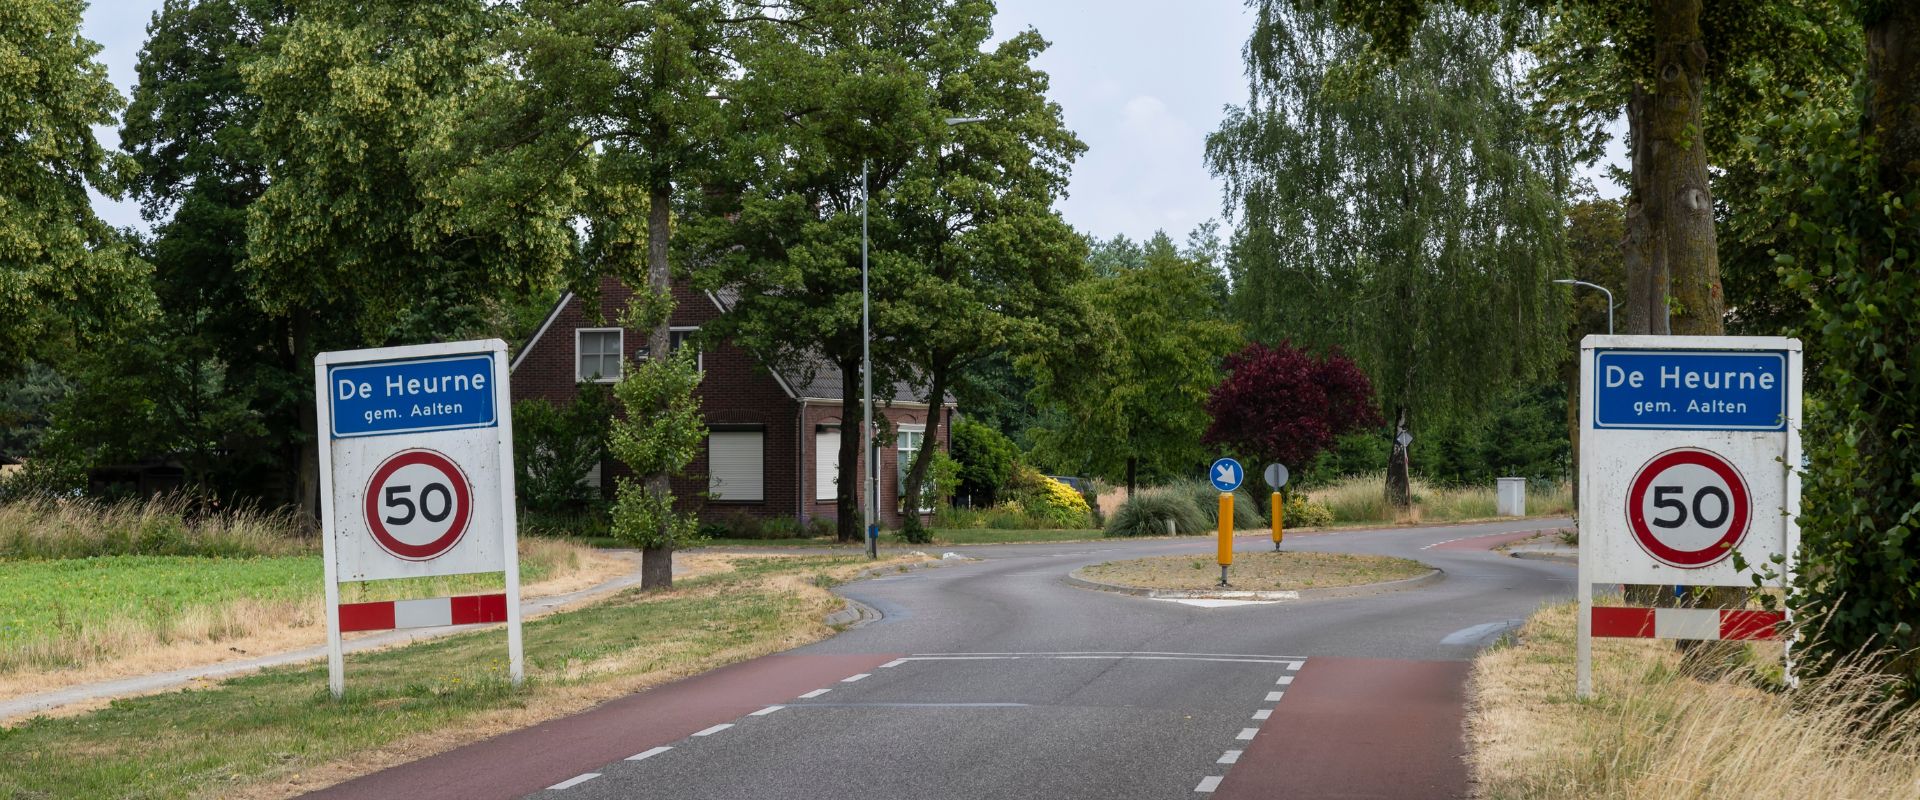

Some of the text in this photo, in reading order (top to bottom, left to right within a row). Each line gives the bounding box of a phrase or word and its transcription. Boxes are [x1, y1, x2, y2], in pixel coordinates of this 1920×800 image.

[338, 372, 486, 400] De Heurne
[1606, 365, 1775, 390] De Heurne
[364, 402, 463, 424] gem. Aalten
[1633, 399, 1747, 416] gem. Aalten
[385, 482, 452, 526] 50
[1652, 485, 1730, 529] 50
